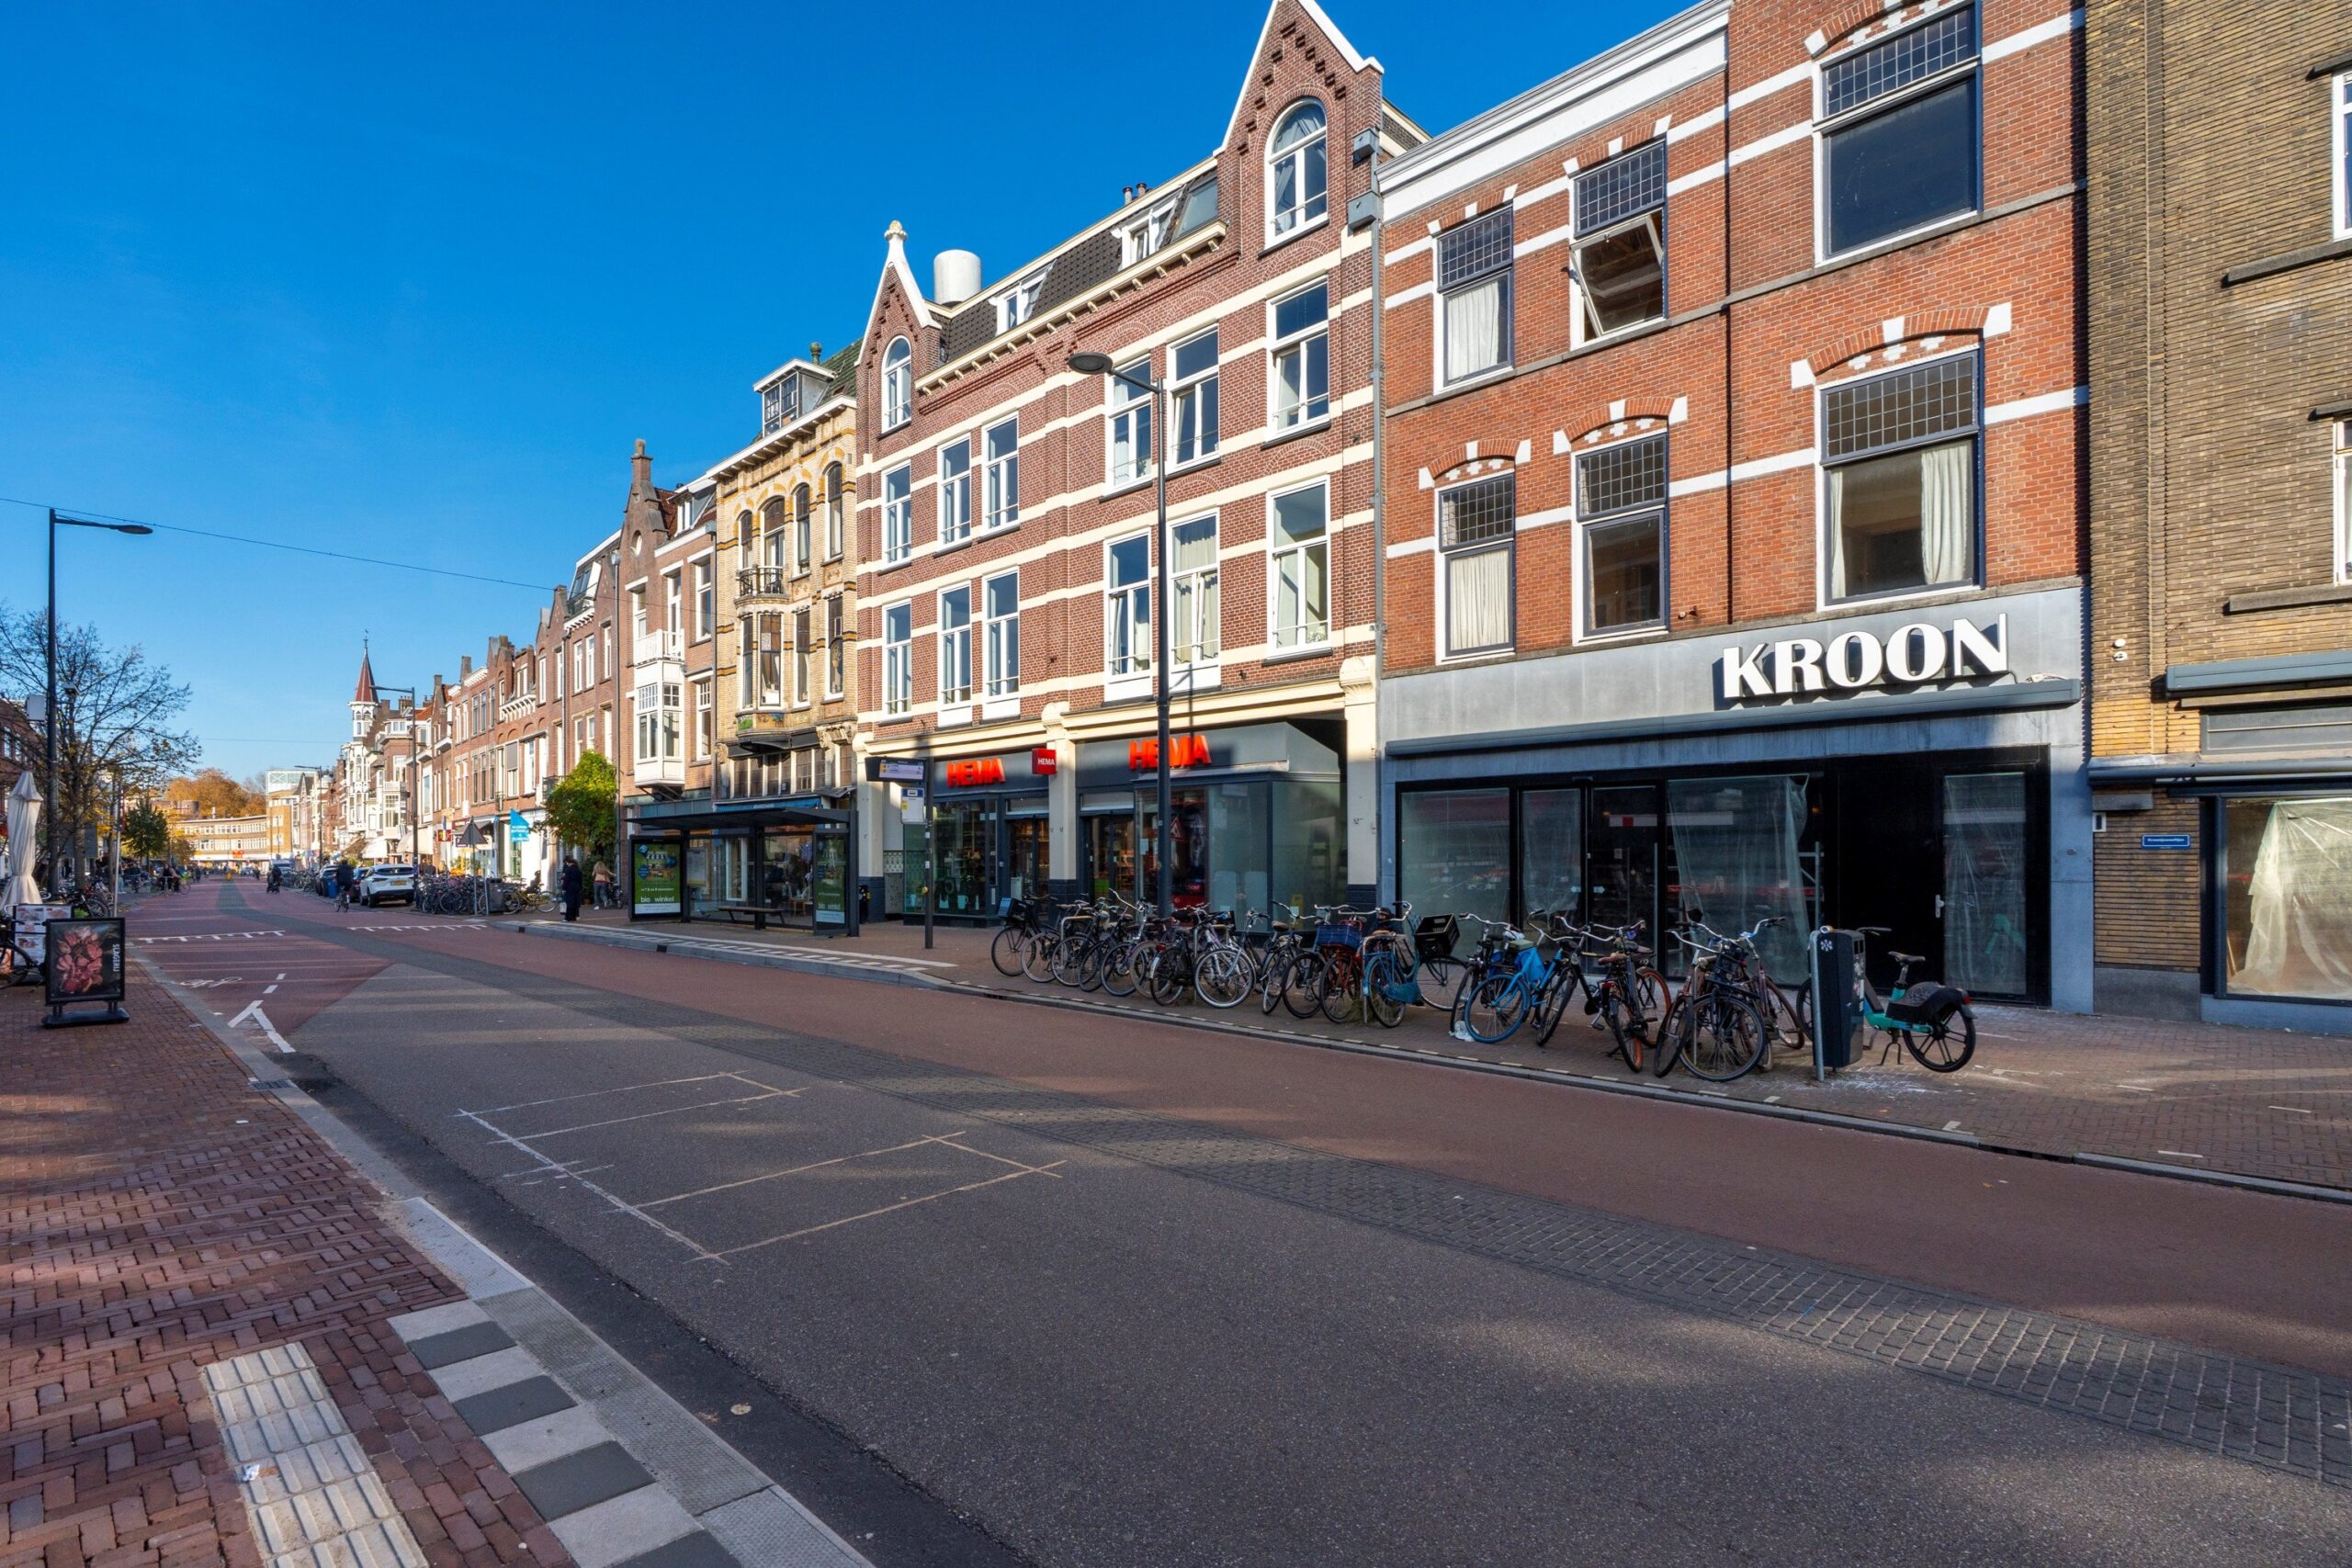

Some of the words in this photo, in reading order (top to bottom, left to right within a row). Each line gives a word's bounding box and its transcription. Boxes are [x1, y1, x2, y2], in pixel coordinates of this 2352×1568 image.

[1724, 613, 2008, 698] KROON
[1129, 735, 1212, 770] HEMA
[946, 759, 1005, 787] HEMA
